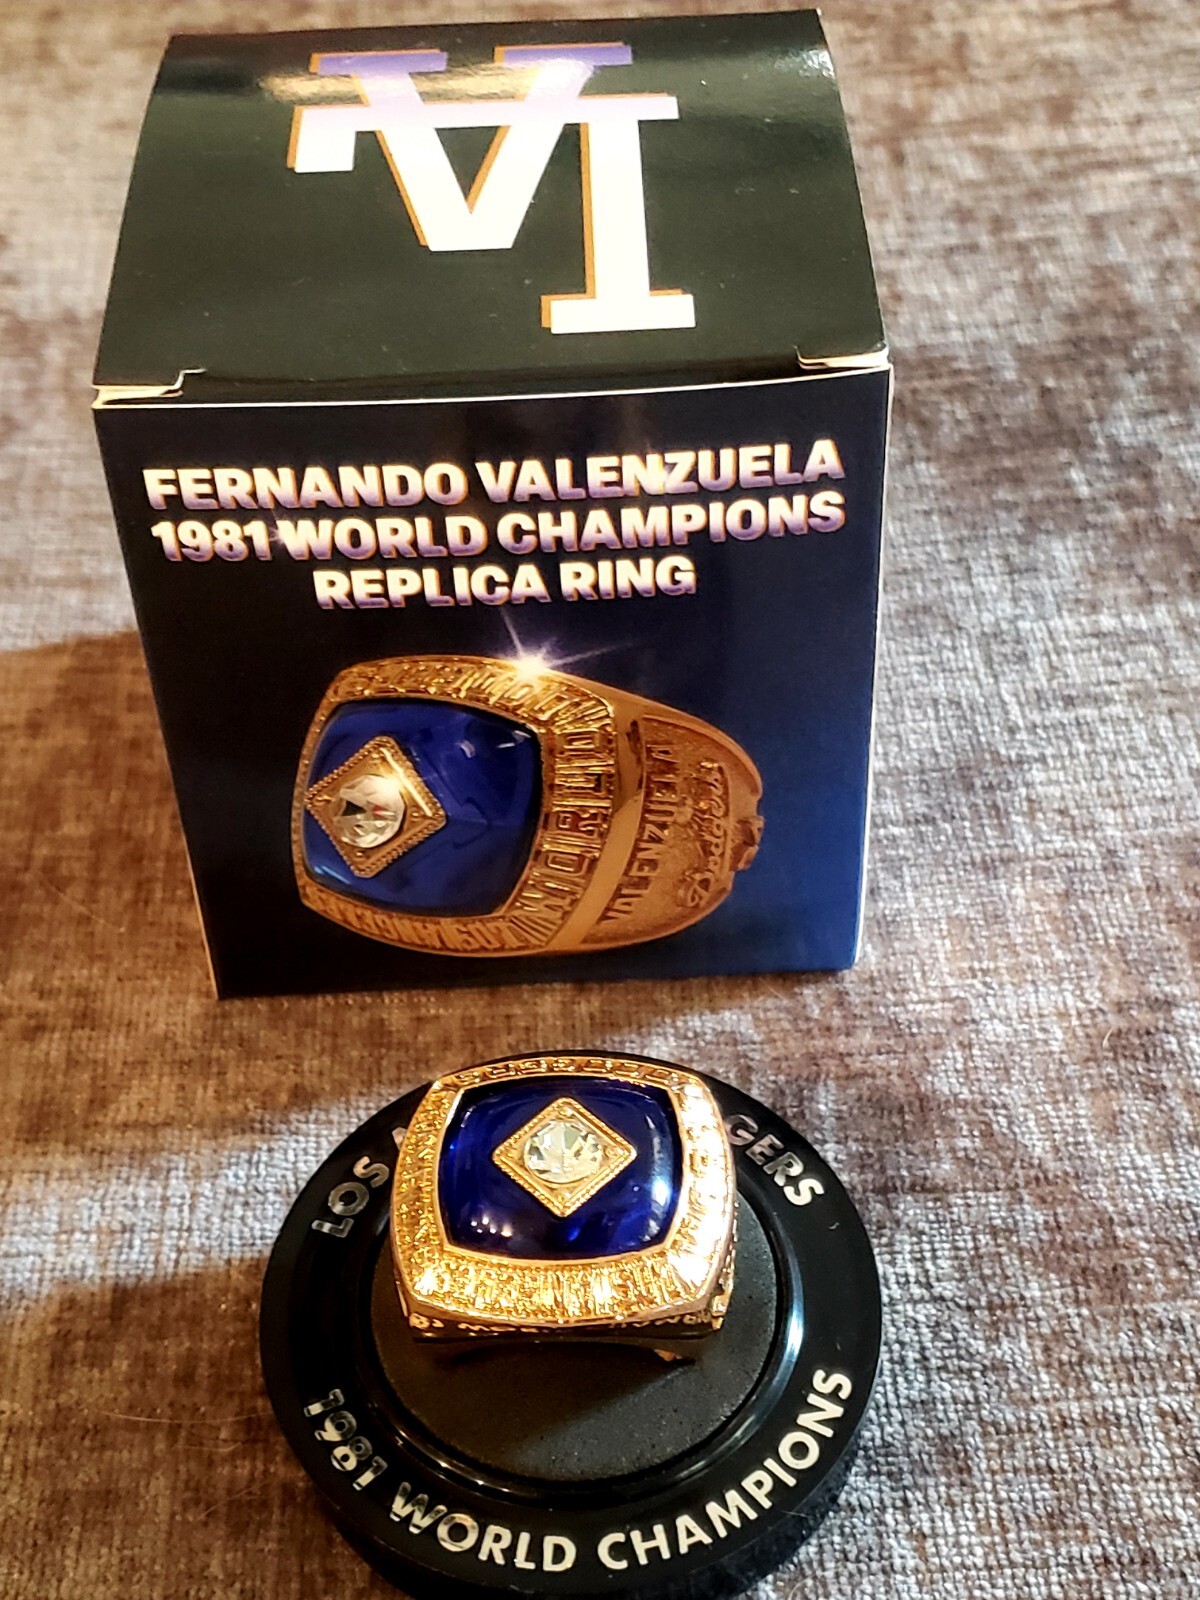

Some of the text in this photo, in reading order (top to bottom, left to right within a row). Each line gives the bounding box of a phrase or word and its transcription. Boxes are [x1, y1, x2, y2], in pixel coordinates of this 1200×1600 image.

[142, 438, 845, 511] FERNANDO VALENZUELA
[151, 488, 846, 564] 1981 WORLD CHAMPIONS
[312, 553, 697, 611] REPLICA RING
[311, 1155, 390, 1238] LOS
[303, 1368, 854, 1573] 1981 WORLD CHAMPIONS
